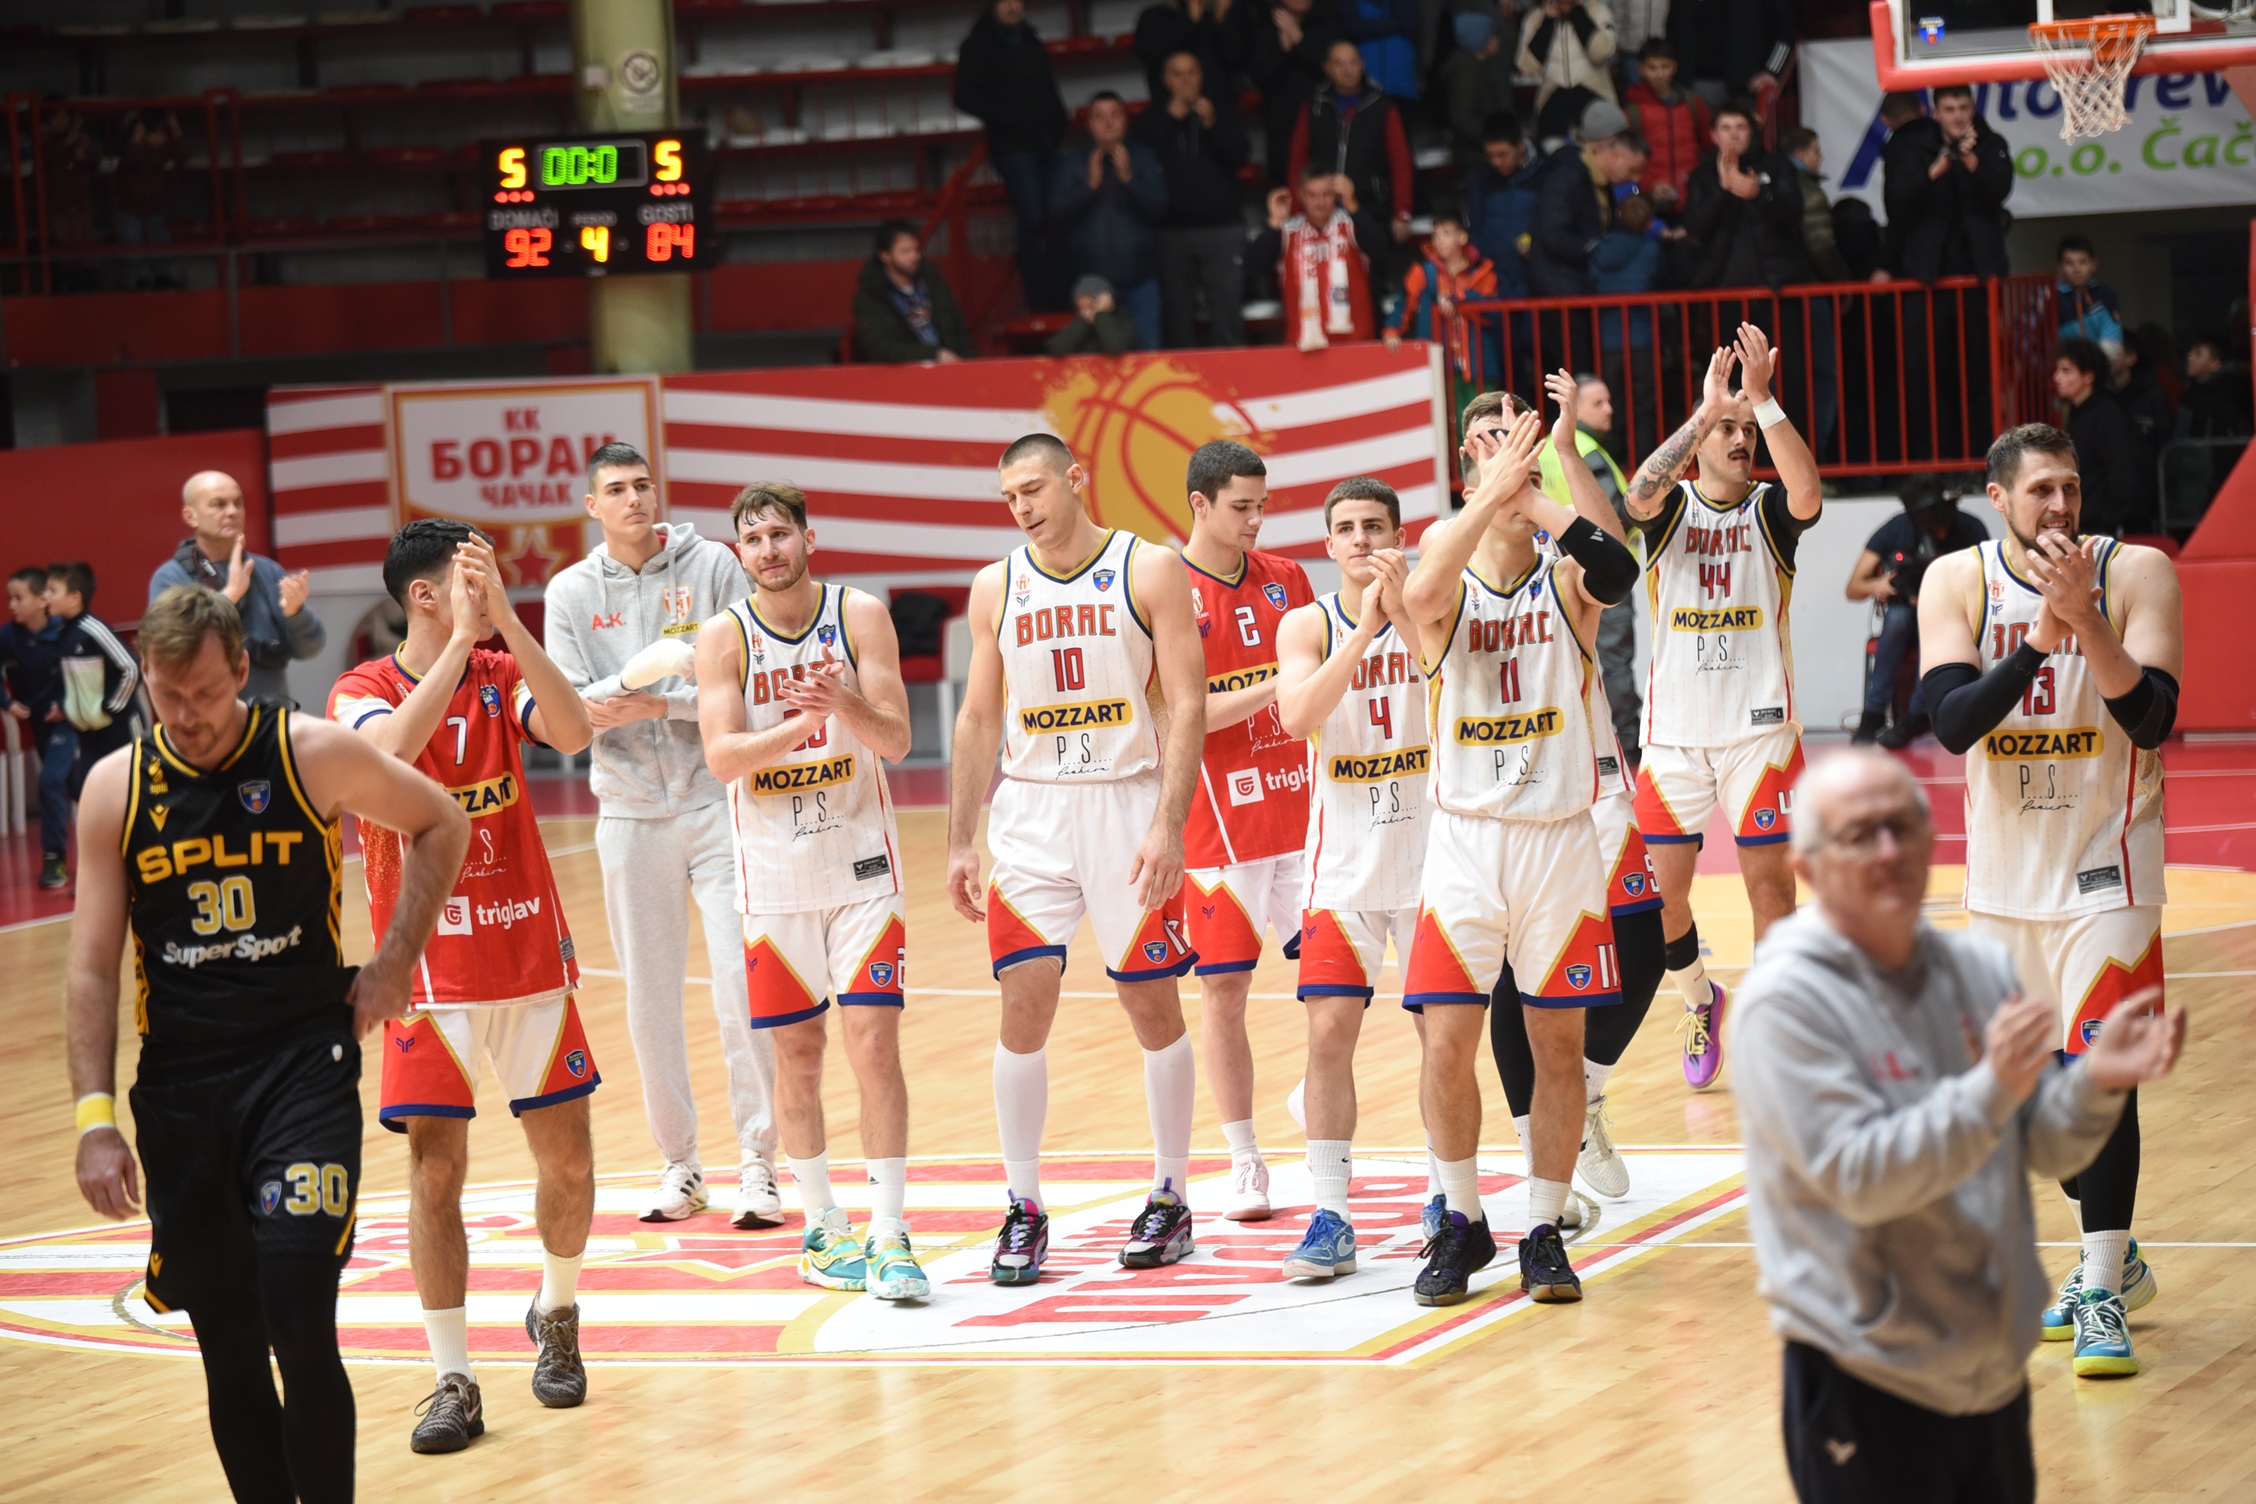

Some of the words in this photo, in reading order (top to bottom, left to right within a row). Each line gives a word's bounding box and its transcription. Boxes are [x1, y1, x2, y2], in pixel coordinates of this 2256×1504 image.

[2141, 115, 2256, 170] Čač
[505, 228, 552, 267] 92
[581, 226, 609, 263] 4
[646, 222, 694, 262] 84
[480, 482, 573, 508] ЧАЧАК
[1684, 524, 1752, 557] BORAC
[1698, 562, 1731, 600] 44
[663, 622, 699, 636] MOZZART
[1015, 604, 1116, 648] BORAC
[1234, 605, 1262, 648] 2
[1468, 611, 1553, 653] BORAC
[1673, 610, 1757, 630] MOZZART
[1050, 647, 1085, 692] 10
[1500, 657, 1521, 704] 11
[2022, 666, 2056, 717] 13
[1022, 702, 1126, 731] MOZZART
[1368, 696, 1393, 740] 4
[1459, 711, 1558, 742] MOZZART
[446, 715, 468, 766] 7
[1986, 731, 2098, 757] MOZZART
[754, 757, 854, 793] MOZZART
[1334, 749, 1428, 779] MOZZART
[136, 831, 303, 884] SPLIT
[187, 875, 256, 935] 30
[476, 897, 541, 930] triglav
[162, 925, 303, 967] SuperSport
[285, 1162, 348, 1217] 30
